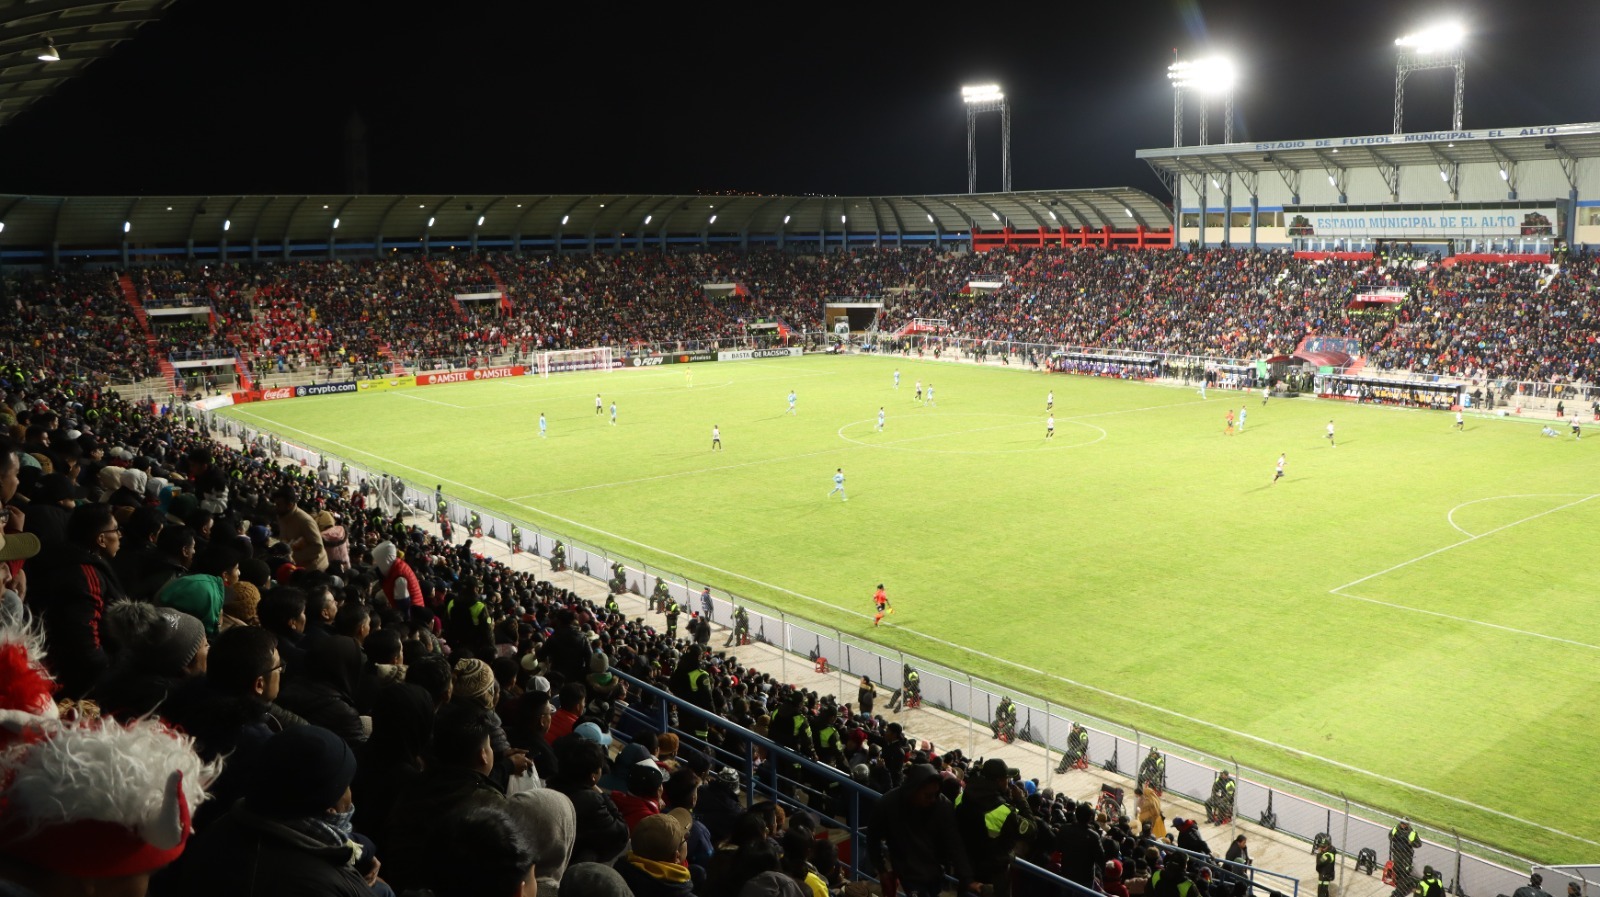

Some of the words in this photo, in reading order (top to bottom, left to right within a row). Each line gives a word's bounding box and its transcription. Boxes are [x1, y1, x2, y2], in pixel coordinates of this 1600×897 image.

[1255, 141, 1305, 151] ESTADIO
[1315, 139, 1331, 147] DE
[1342, 136, 1392, 145] FUTBOL
[1404, 131, 1475, 142] MUNICIPAL
[1488, 130, 1505, 138] EL
[1519, 127, 1557, 136] ALTO
[1317, 217, 1366, 229] ESTADIO
[1369, 217, 1435, 228] MUNICIPAL
[1440, 216, 1456, 228] DE
[1461, 216, 1476, 228] EL
[1482, 216, 1516, 228] ALTO
[437, 372, 468, 384] AMSTEL
[482, 368, 513, 379] AMSTEL
[308, 382, 356, 395] crypto.com
